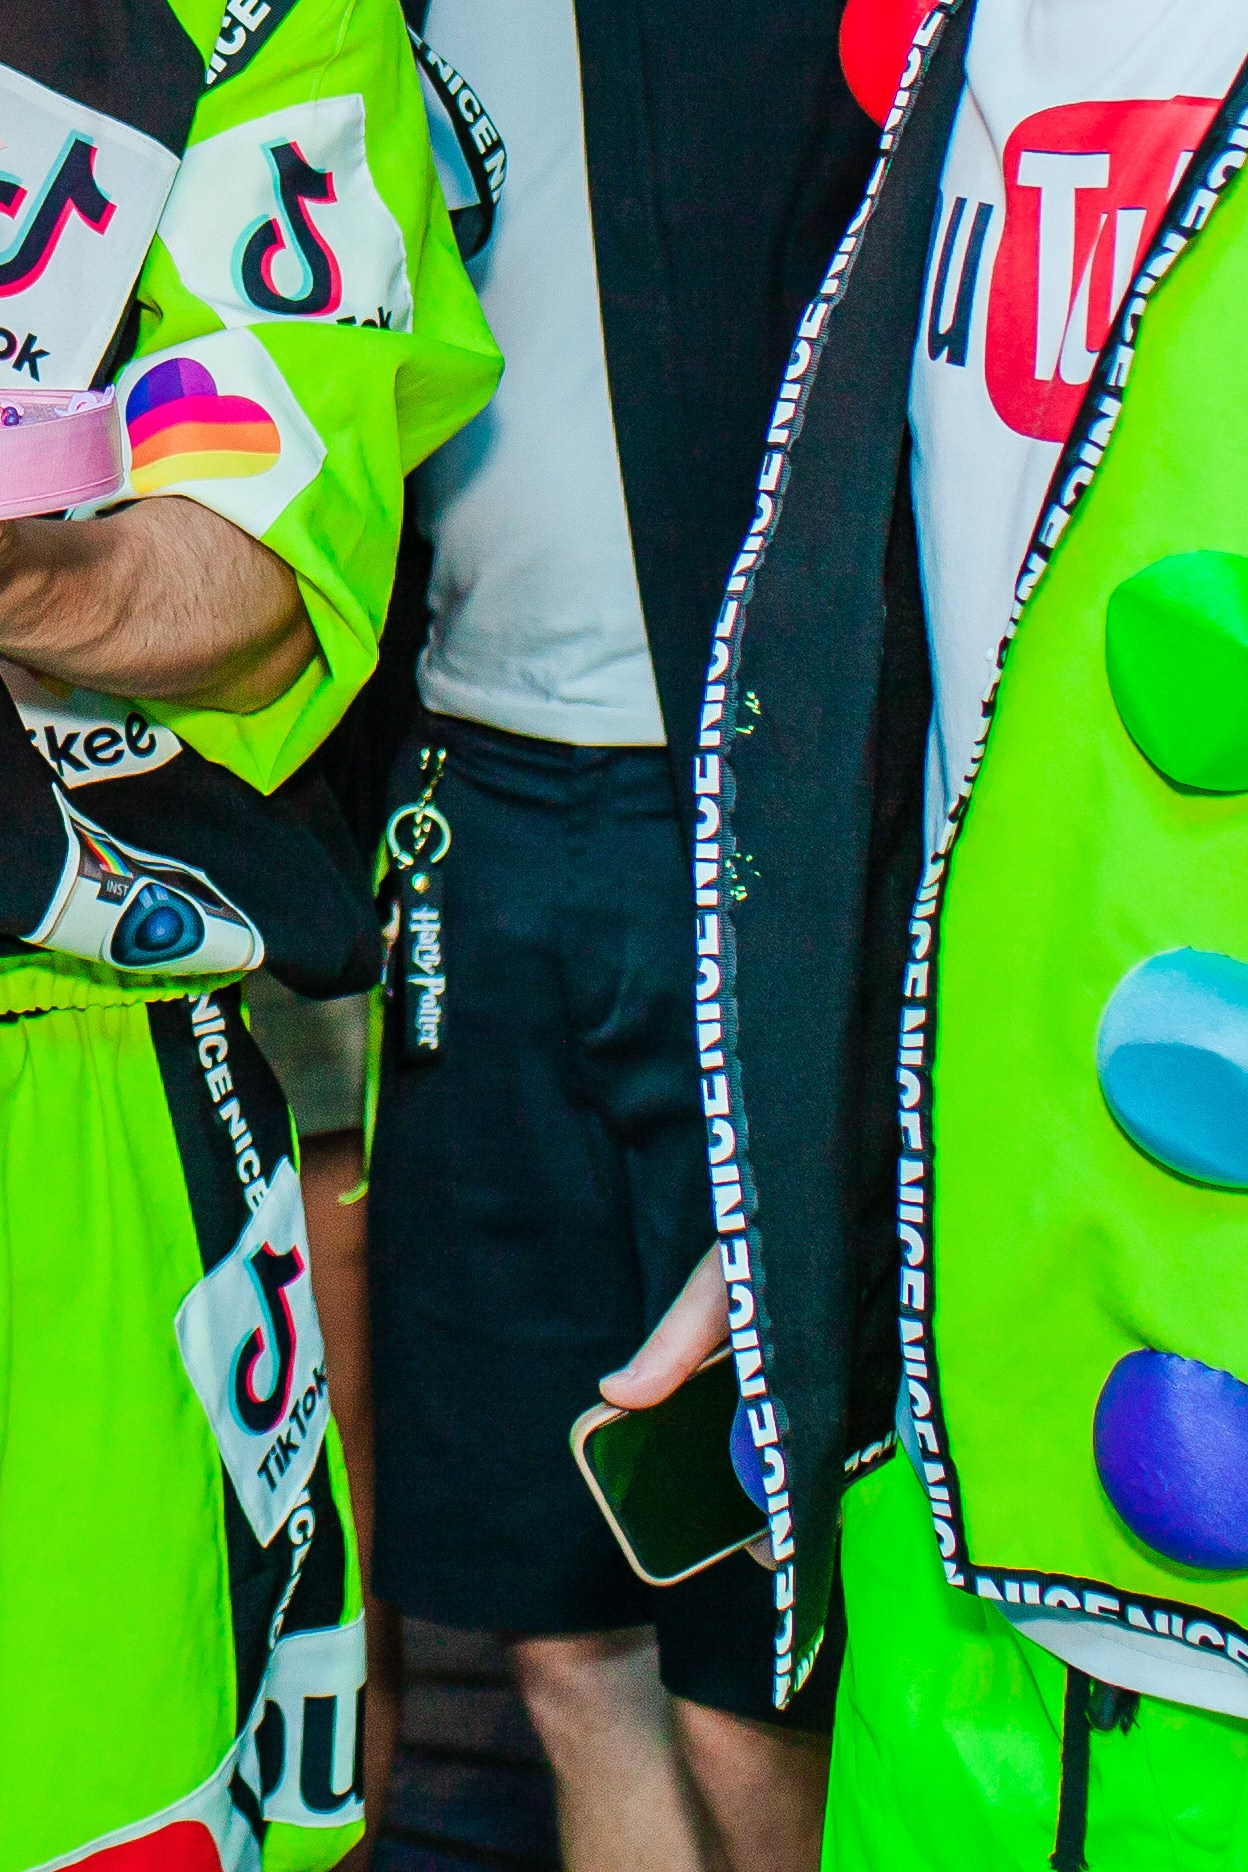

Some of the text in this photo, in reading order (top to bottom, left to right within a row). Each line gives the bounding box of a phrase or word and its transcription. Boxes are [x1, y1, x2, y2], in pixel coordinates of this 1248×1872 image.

[426, 48, 499, 155] NICE
[26, 711, 157, 776] kee
[188, 993, 269, 1212] NICE NICE
[701, 1074, 746, 1233] NICE
[720, 1239, 767, 1398] NICE
